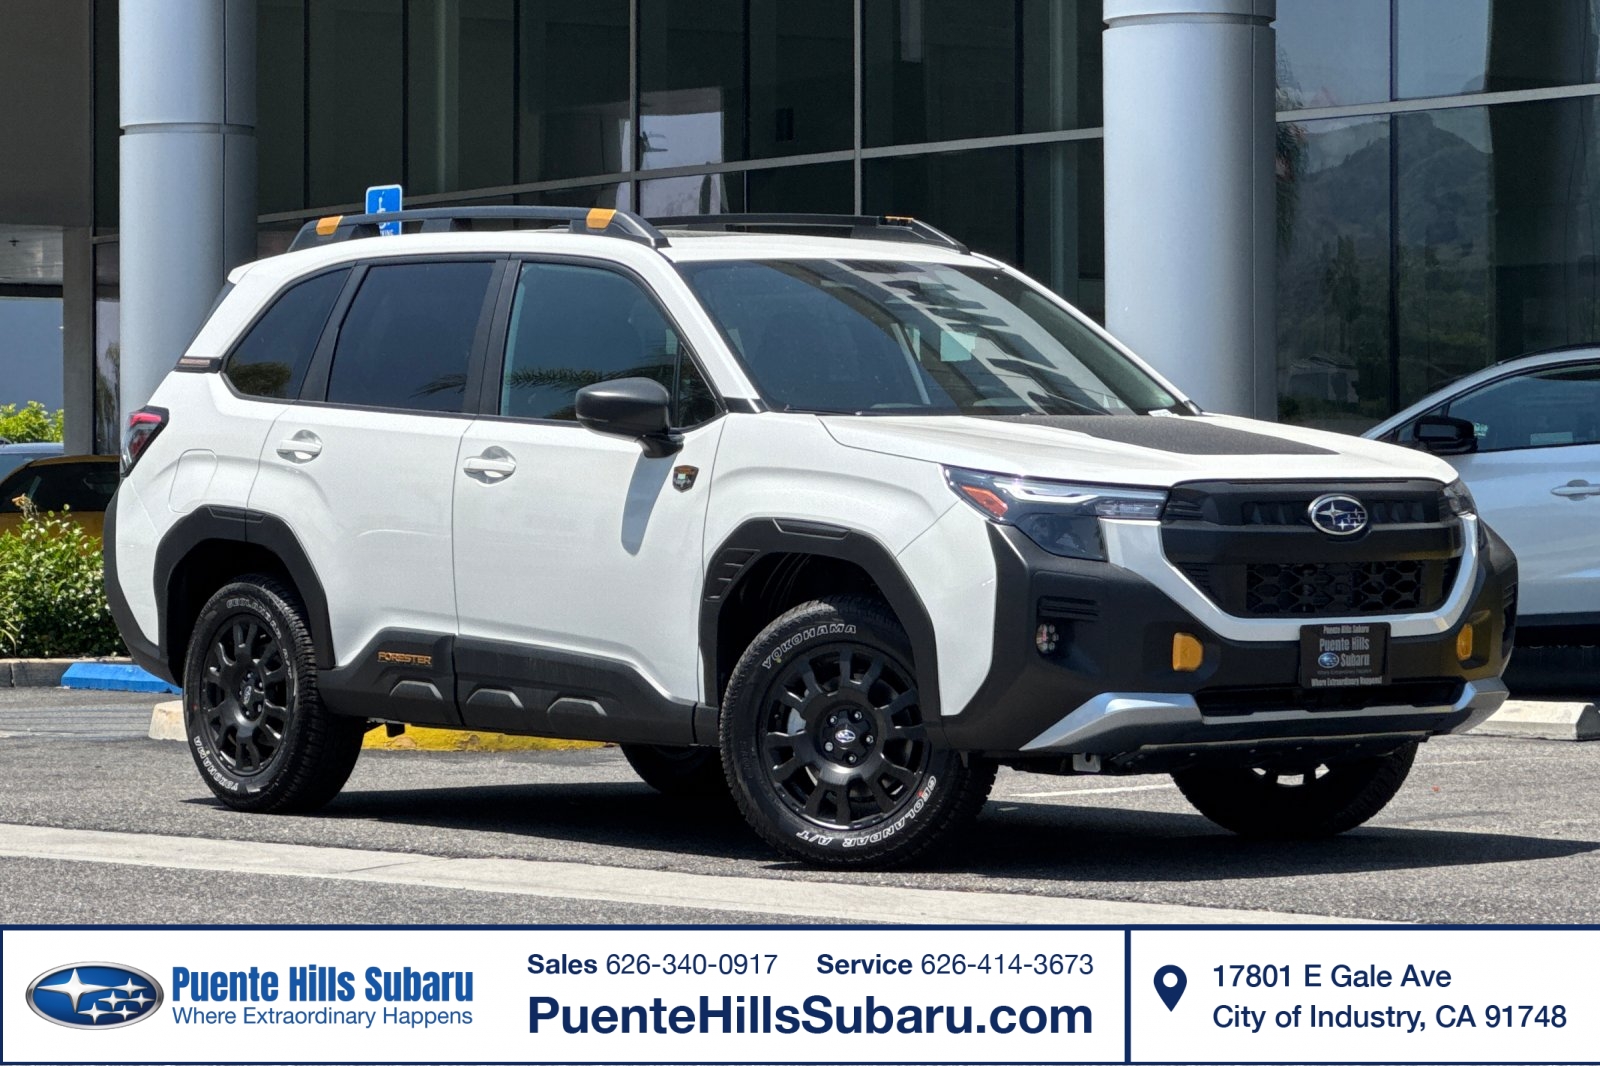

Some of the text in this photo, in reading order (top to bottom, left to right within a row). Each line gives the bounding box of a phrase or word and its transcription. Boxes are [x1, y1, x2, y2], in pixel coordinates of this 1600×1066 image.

[762, 623, 857, 670] YOKOHAMA
[1320, 636, 1370, 652] Puente Hills
[377, 651, 432, 665] FORESTER
[1340, 653, 1370, 667] Subaru
[796, 775, 937, 848] GEOLANDAR A/T
